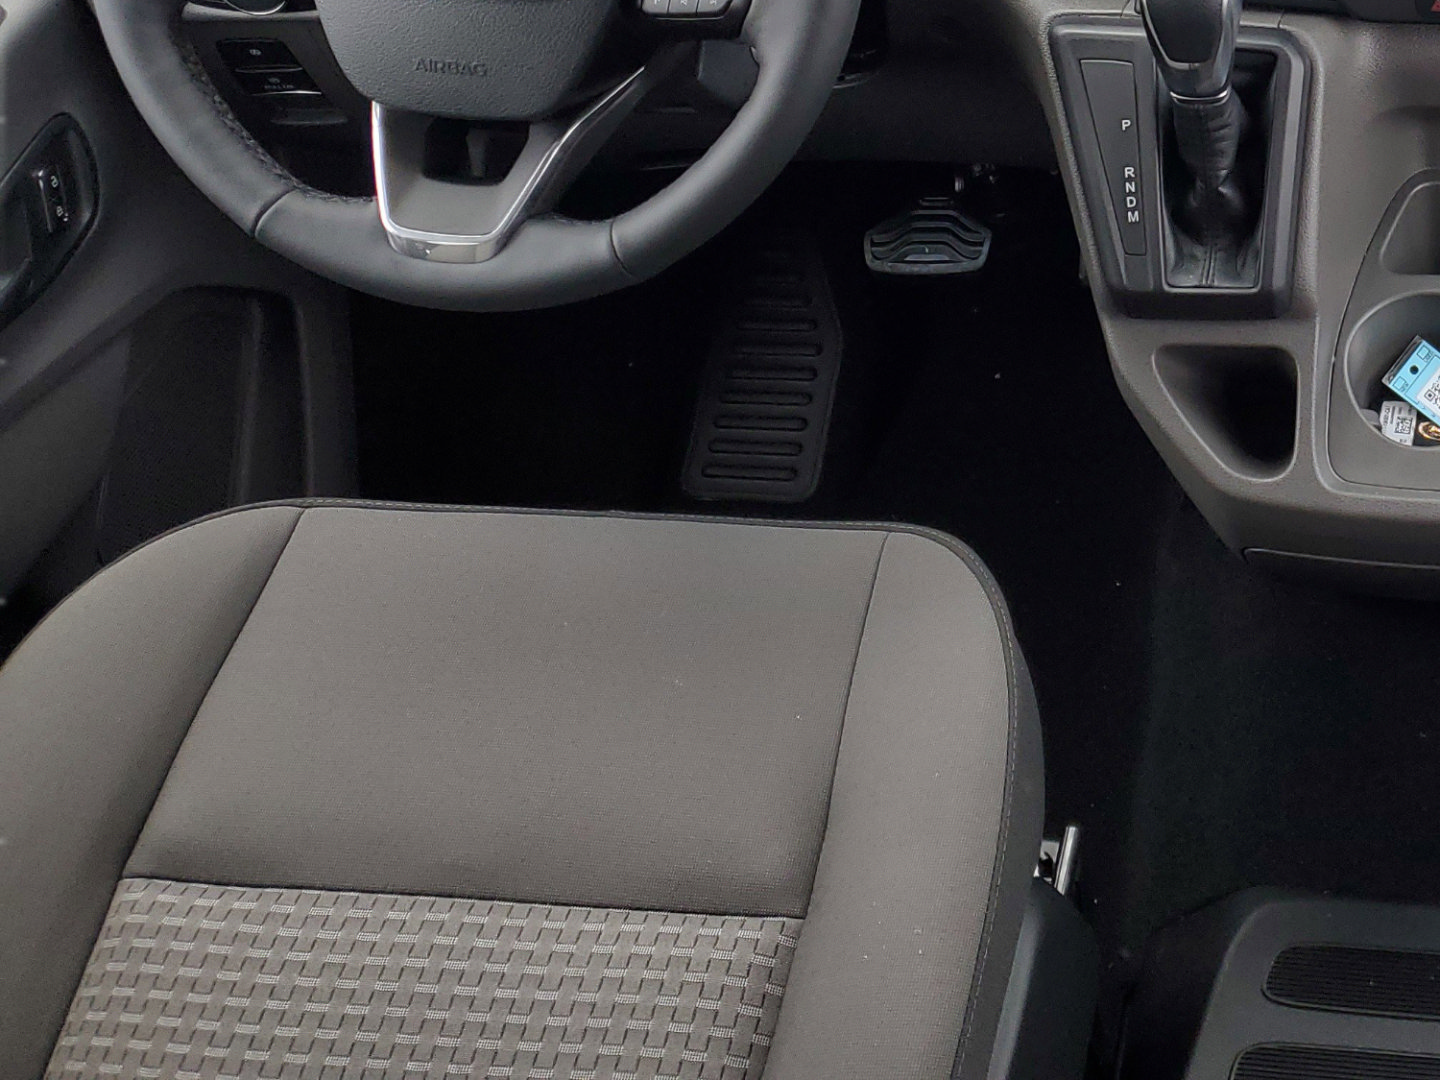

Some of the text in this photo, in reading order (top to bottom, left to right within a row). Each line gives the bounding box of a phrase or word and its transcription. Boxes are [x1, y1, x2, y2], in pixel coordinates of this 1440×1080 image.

[415, 57, 488, 75] AIRBAG
[1122, 120, 1131, 131] P
[1124, 167, 1135, 178] R
[1125, 182, 1136, 193] N
[1126, 196, 1137, 208] D
[1127, 211, 1139, 223] M
